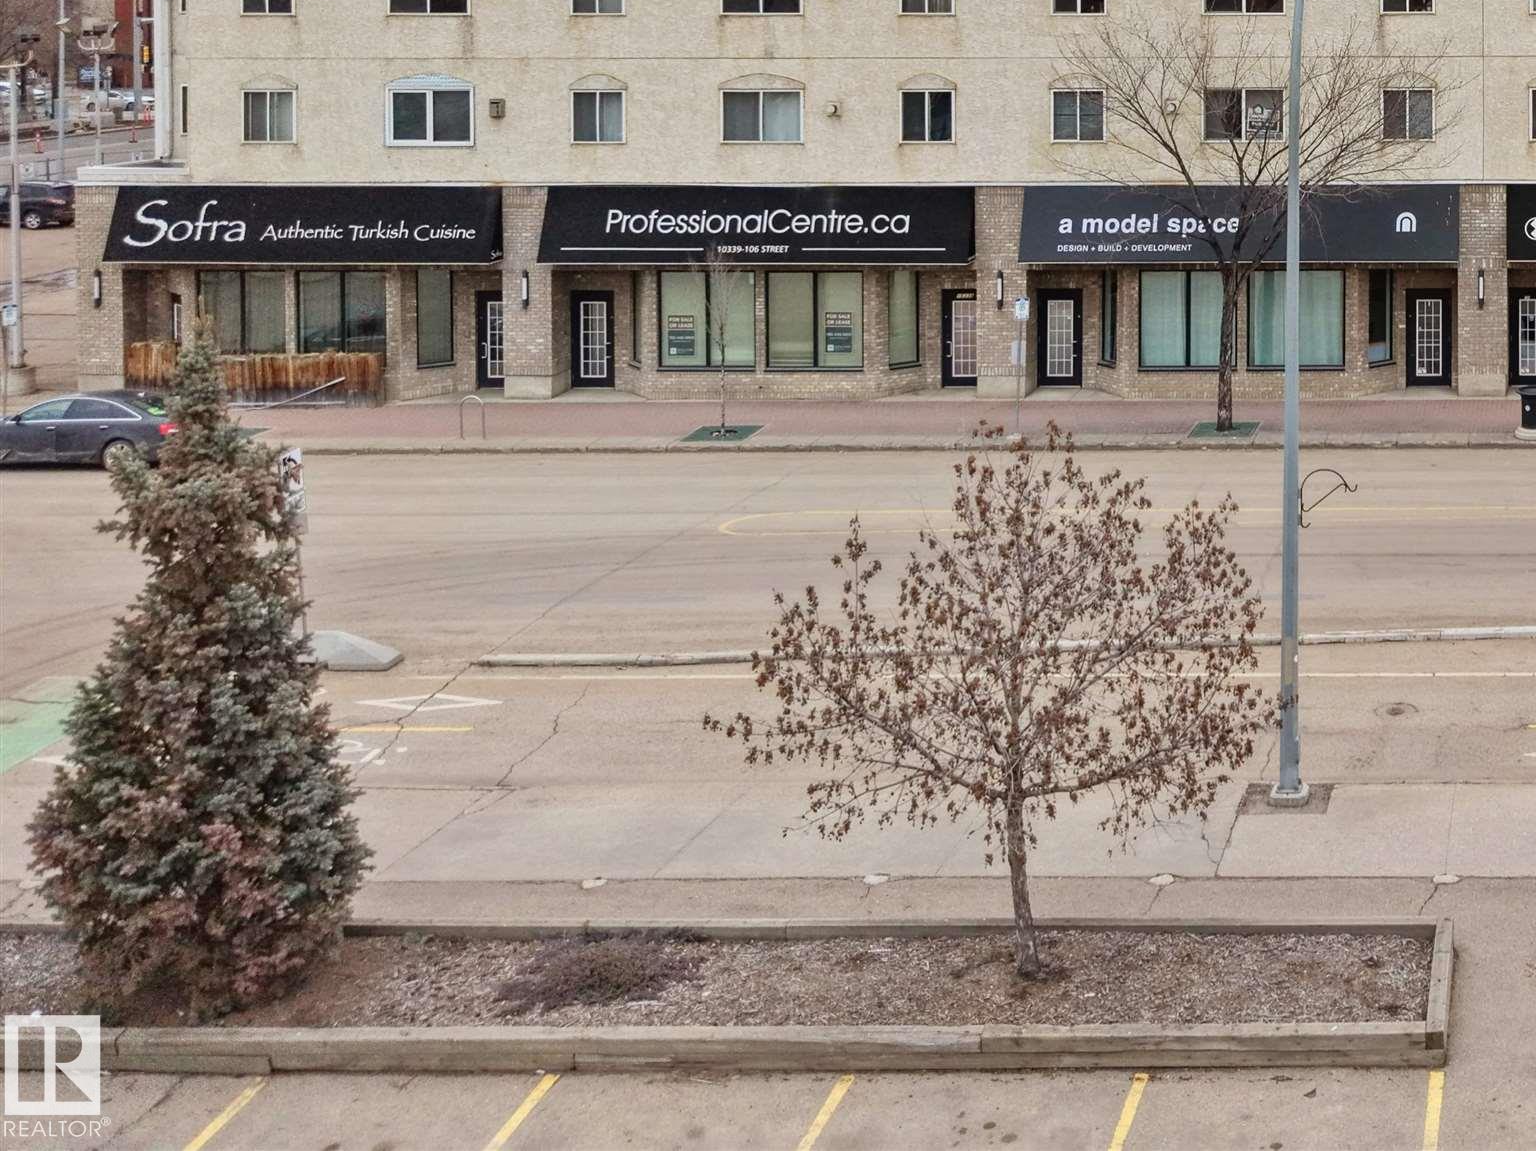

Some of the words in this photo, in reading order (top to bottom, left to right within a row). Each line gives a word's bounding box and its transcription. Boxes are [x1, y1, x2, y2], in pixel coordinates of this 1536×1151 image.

[122, 199, 247, 248] Sofra
[259, 220, 344, 242] Authentic
[348, 220, 409, 242] Turkish
[413, 224, 477, 242] Cuisine
[605, 208, 911, 235] ProfessionalCentre.ca
[1058, 217, 1073, 234] a
[1081, 213, 1159, 234] model
[716, 244, 760, 254] 10339-106
[760, 244, 790, 254] STREET
[1057, 244, 1089, 252] DESIGN
[1097, 243, 1123, 252] BUILD
[1131, 243, 1193, 252] DEVELOPMENT
